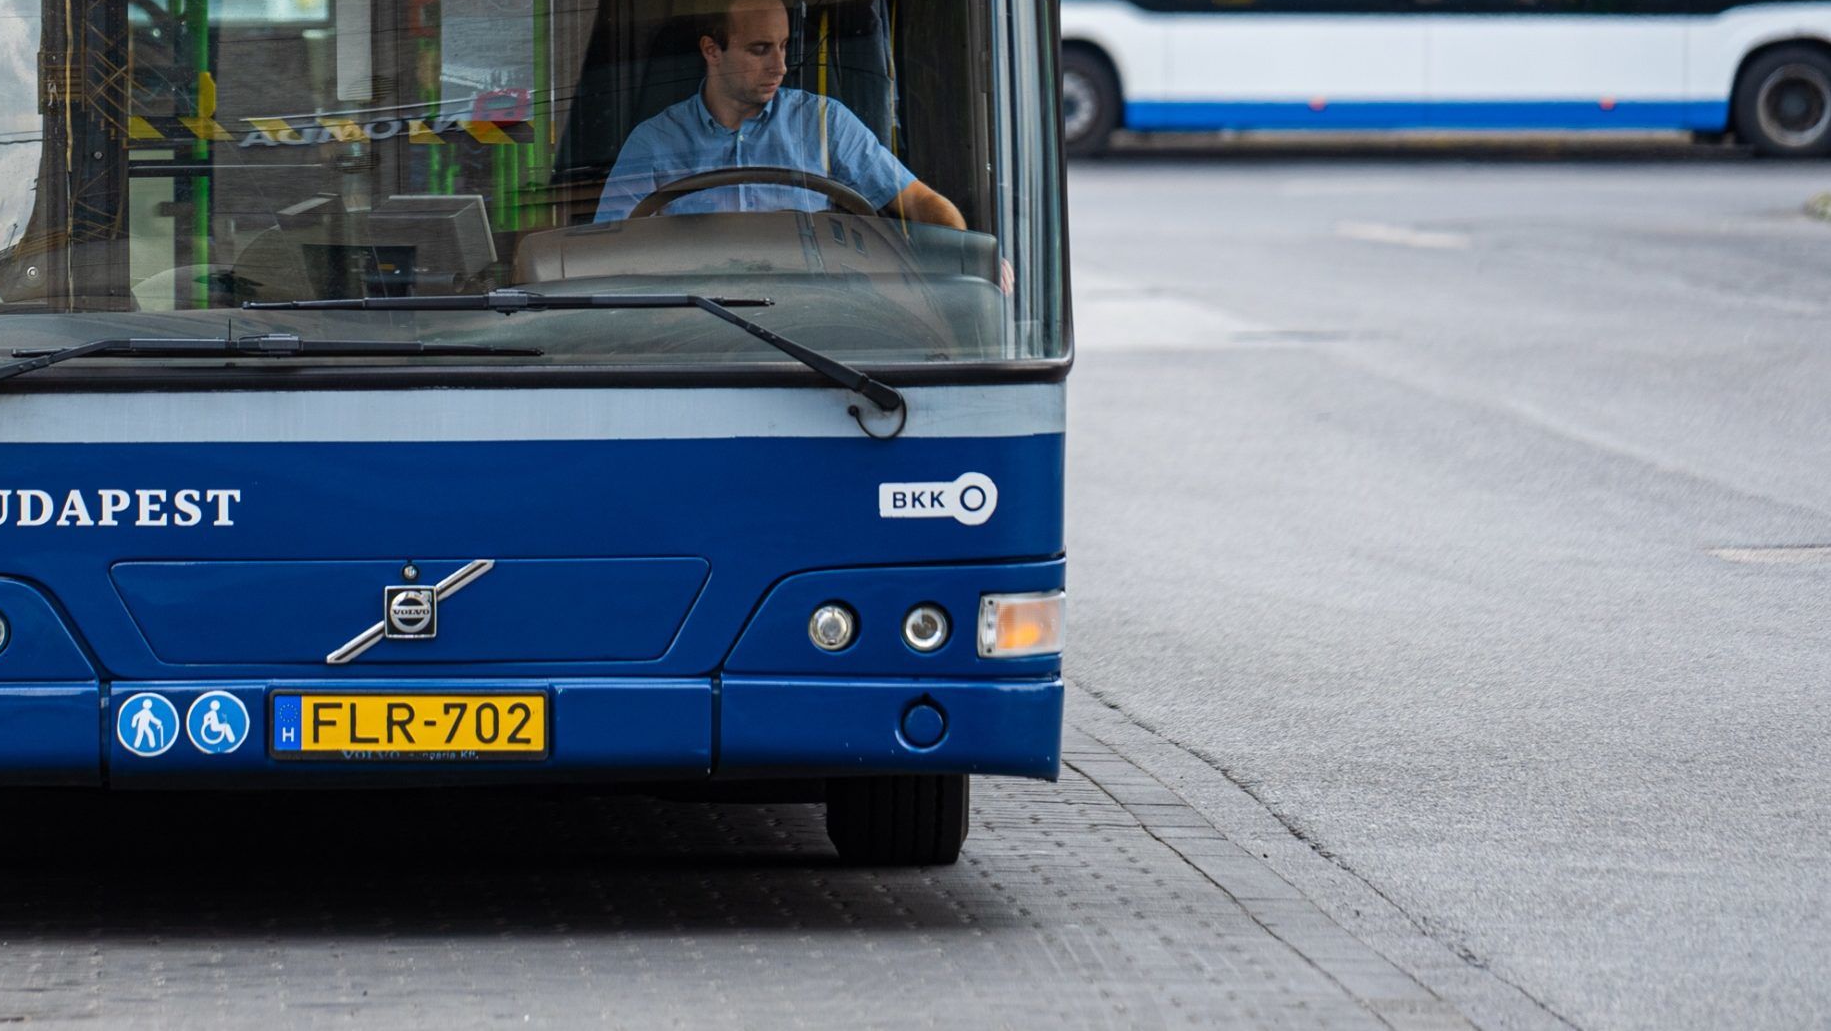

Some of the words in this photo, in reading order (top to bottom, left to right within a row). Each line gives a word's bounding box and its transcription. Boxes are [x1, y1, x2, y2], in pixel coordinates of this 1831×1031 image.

[892, 490, 946, 509] BKK
[312, 702, 532, 744] FLR-702
[282, 727, 295, 742] H
